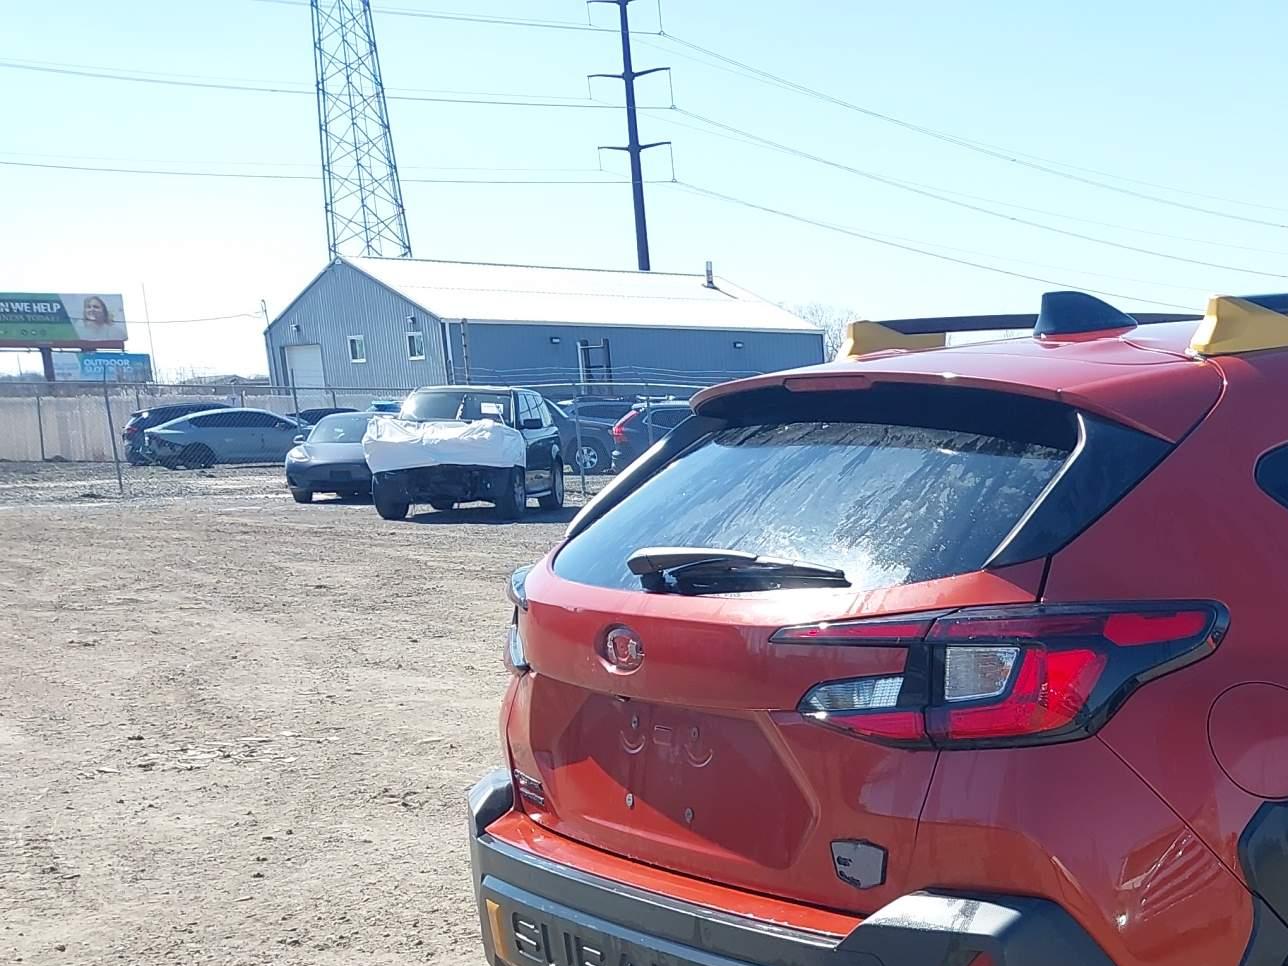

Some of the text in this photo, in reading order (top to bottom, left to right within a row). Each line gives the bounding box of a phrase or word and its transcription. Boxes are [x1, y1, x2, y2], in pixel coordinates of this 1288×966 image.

[11, 302, 31, 313] WE
[32, 302, 61, 313] HELP
[83, 358, 130, 367] OUTDOOR
